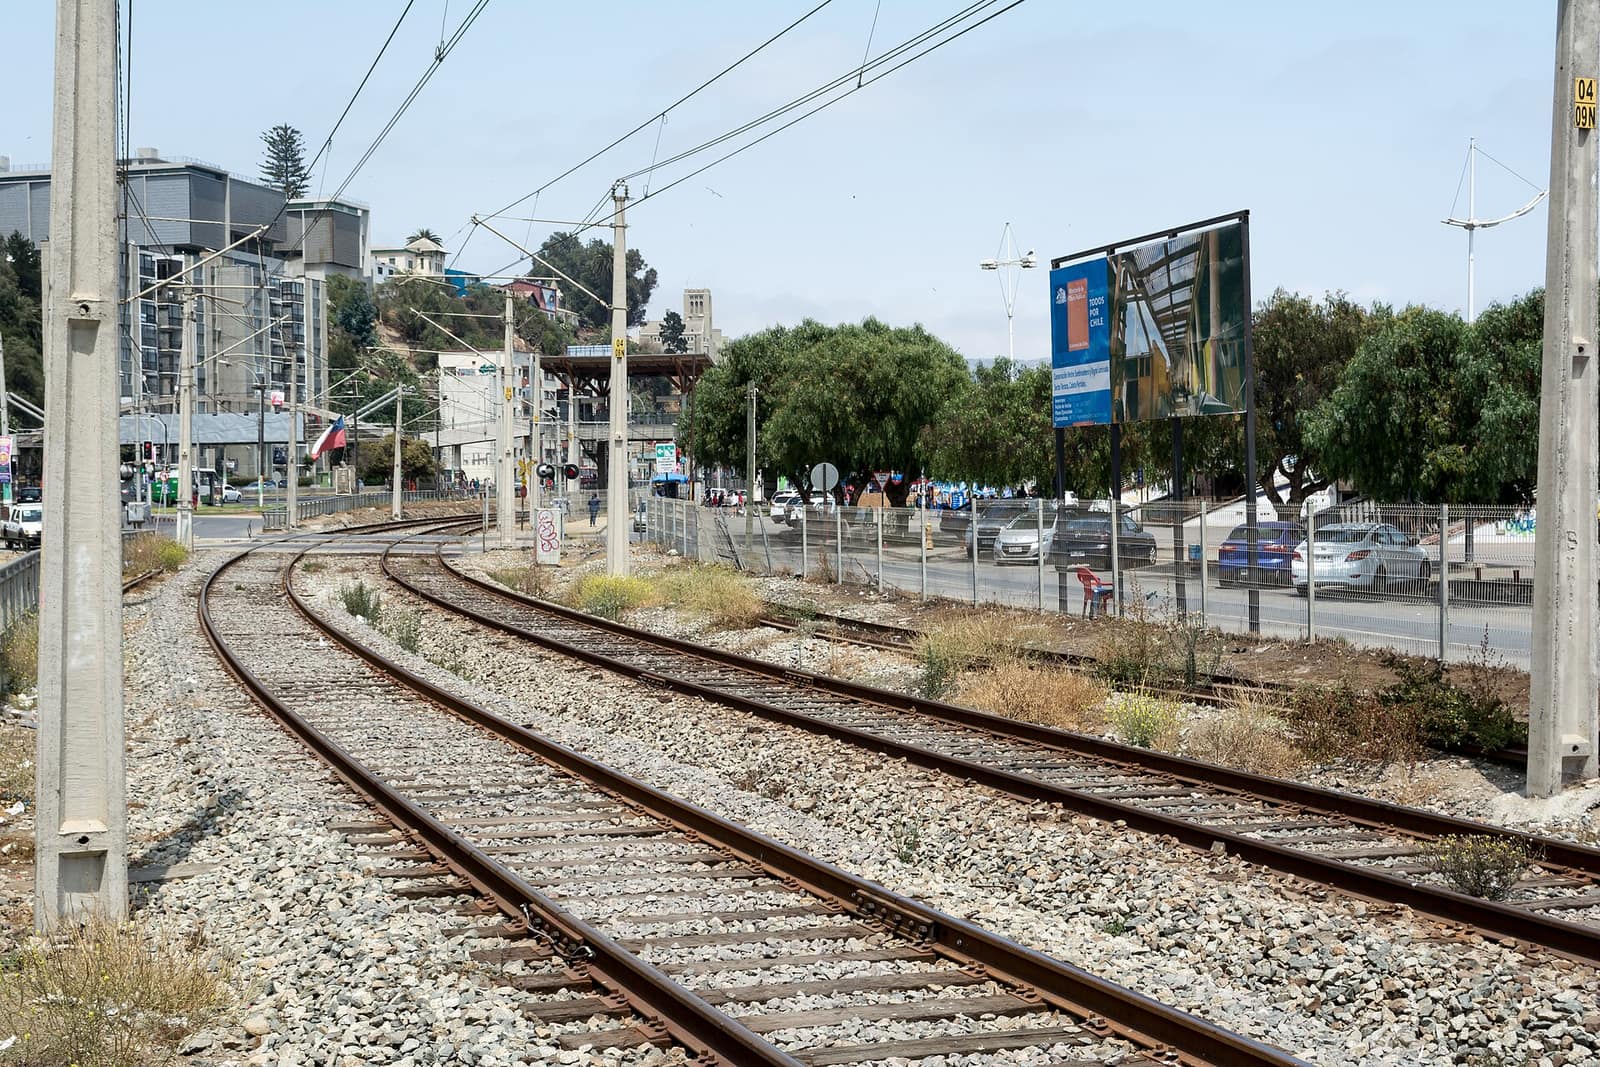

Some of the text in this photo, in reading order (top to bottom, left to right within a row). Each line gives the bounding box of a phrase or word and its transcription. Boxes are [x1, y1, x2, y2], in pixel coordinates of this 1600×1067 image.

[1578, 79, 1593, 101] 04
[1575, 105, 1596, 127] 09N
[1089, 296, 1104, 307] TODOS
[1089, 307, 1099, 317] POR
[1090, 317, 1104, 327] CHILE
